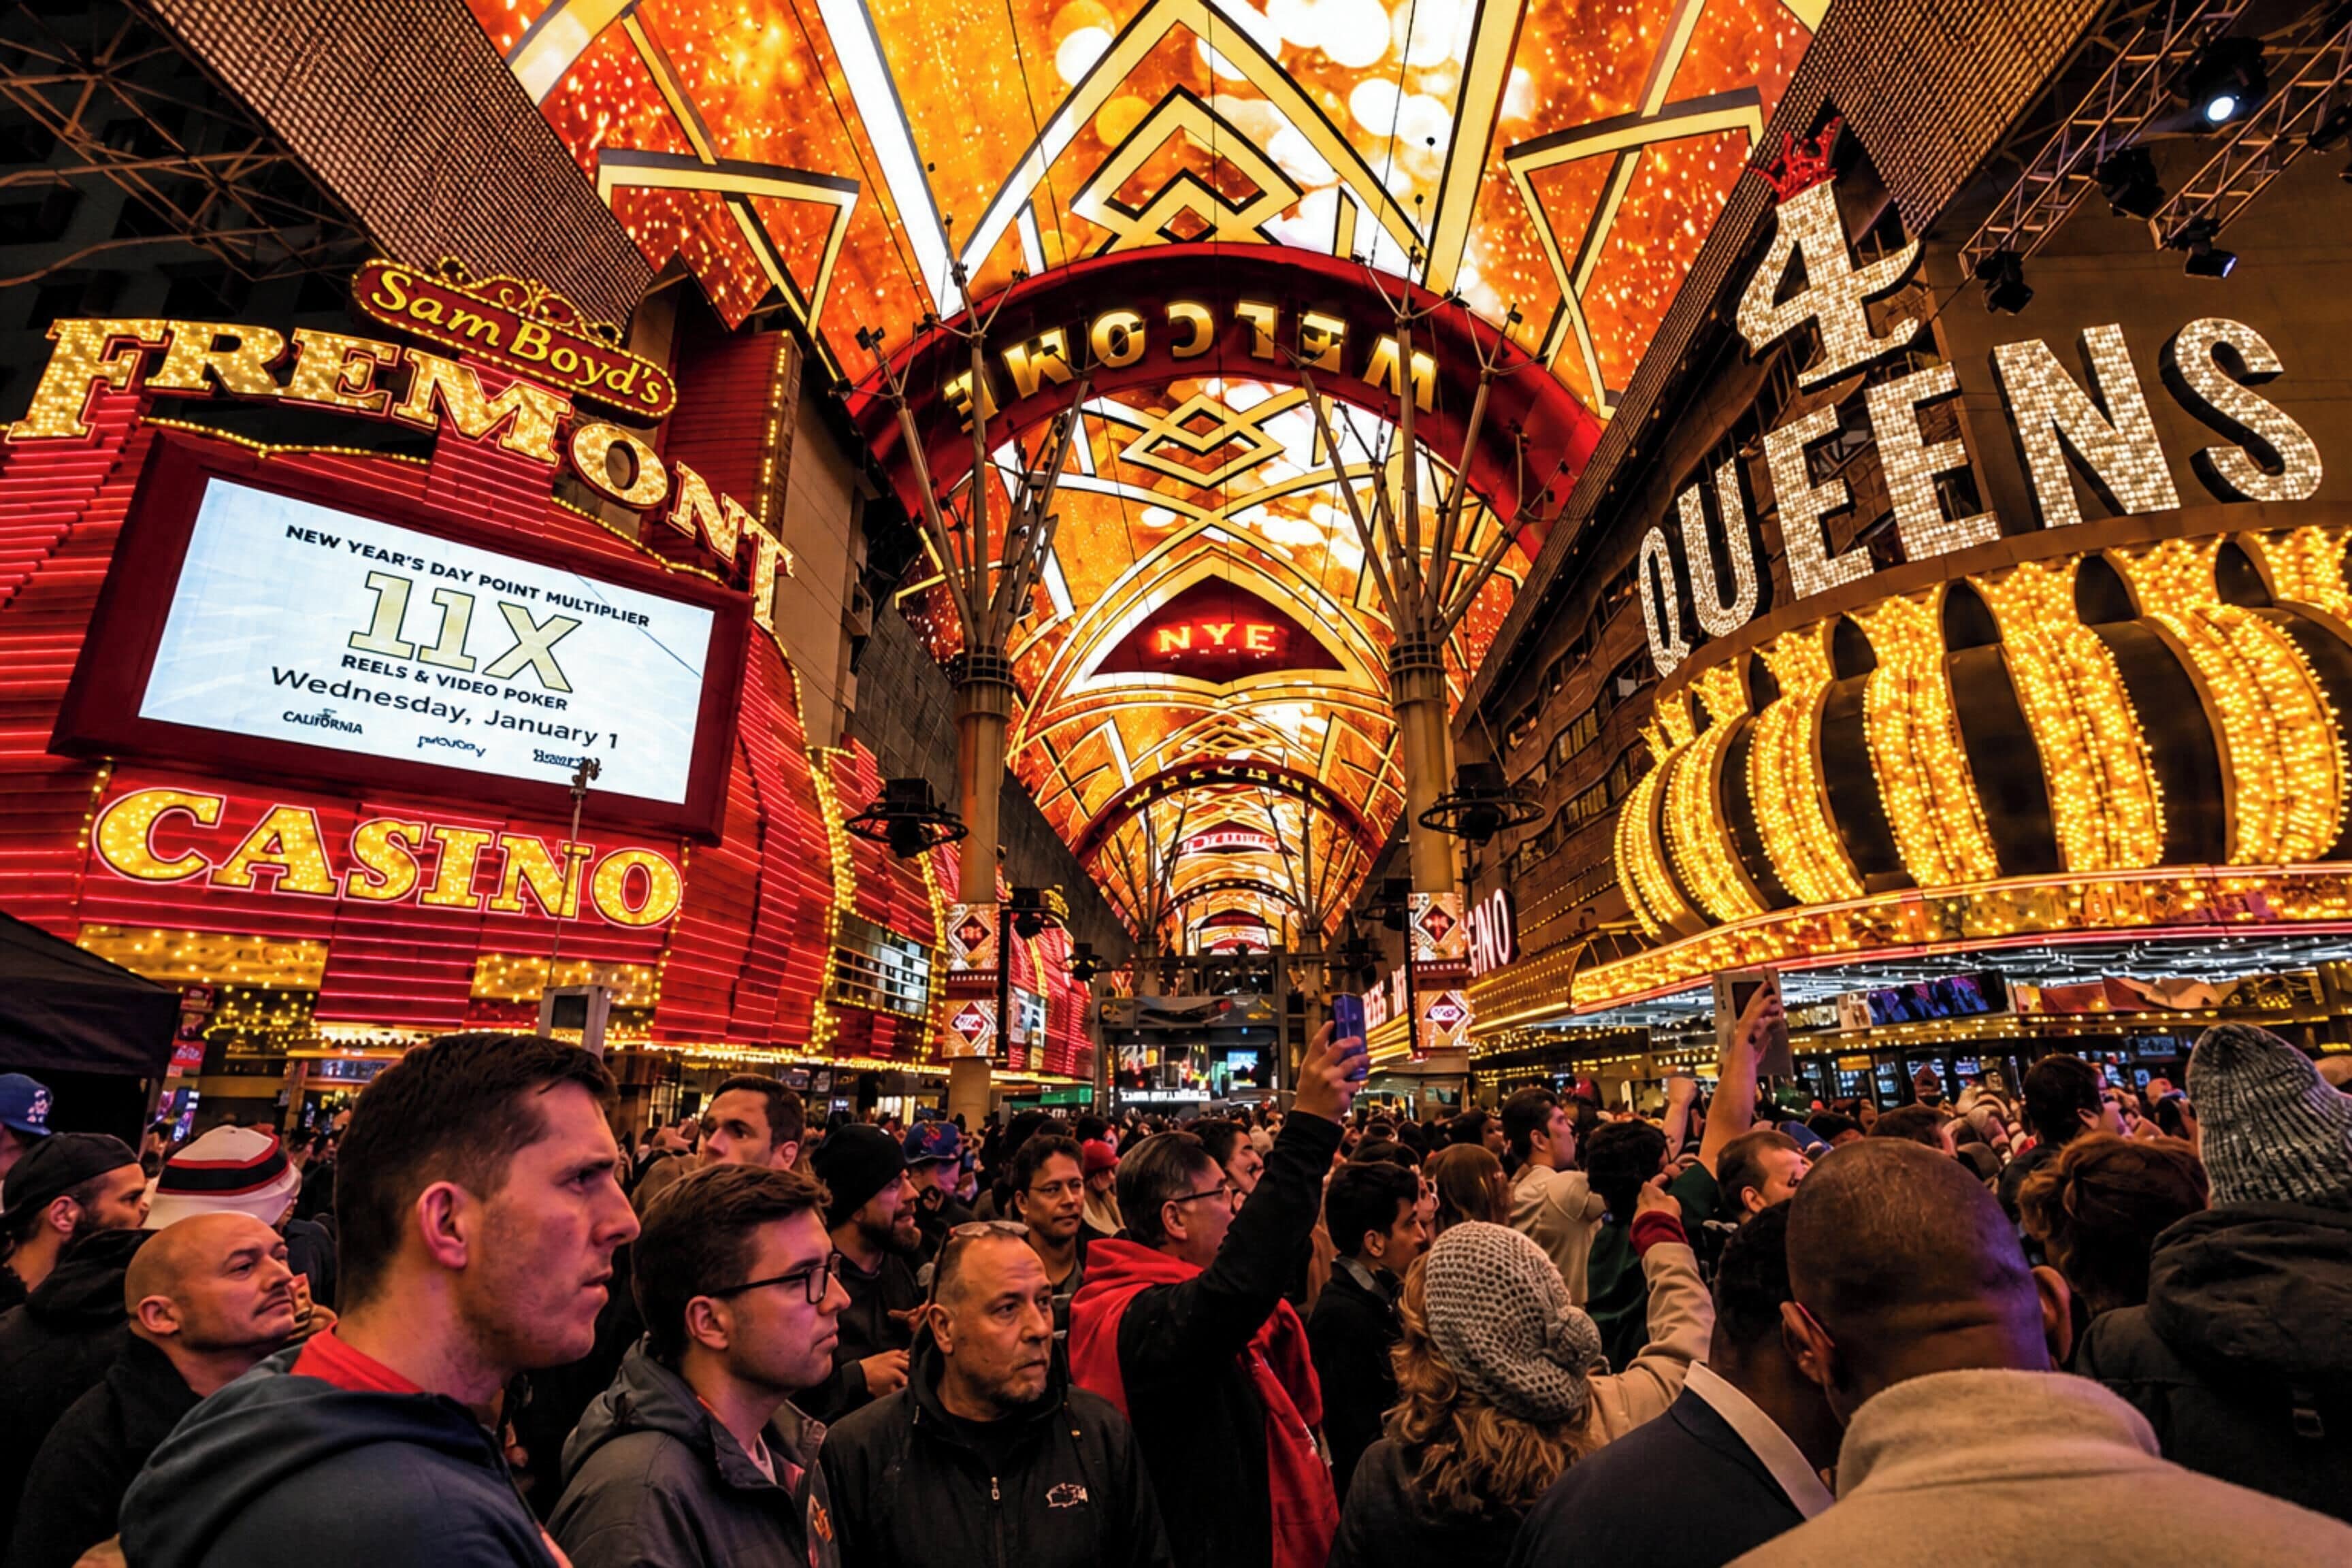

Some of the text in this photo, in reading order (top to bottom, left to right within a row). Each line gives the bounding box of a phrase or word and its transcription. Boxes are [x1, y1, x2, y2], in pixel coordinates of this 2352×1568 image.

[371, 270, 662, 406] Sam Boyd's
[1736, 181, 1923, 391] 4
[944, 300, 1437, 434] WELCOME
[5, 318, 794, 630] FREMONT
[1639, 316, 2323, 679] QUEENS
[286, 525, 650, 627] NEW YEAR'S DAY POINT MULTIPLIER
[348, 570, 583, 693] 11X
[1158, 623, 1276, 653] NYE
[272, 666, 472, 725] Wednesday,
[484, 710, 598, 748] January
[608, 733, 619, 749] 1
[282, 710, 363, 734] CALIFORNIA
[342, 654, 568, 710] REELS & VIDEO POKER
[93, 787, 683, 928] CASINO
